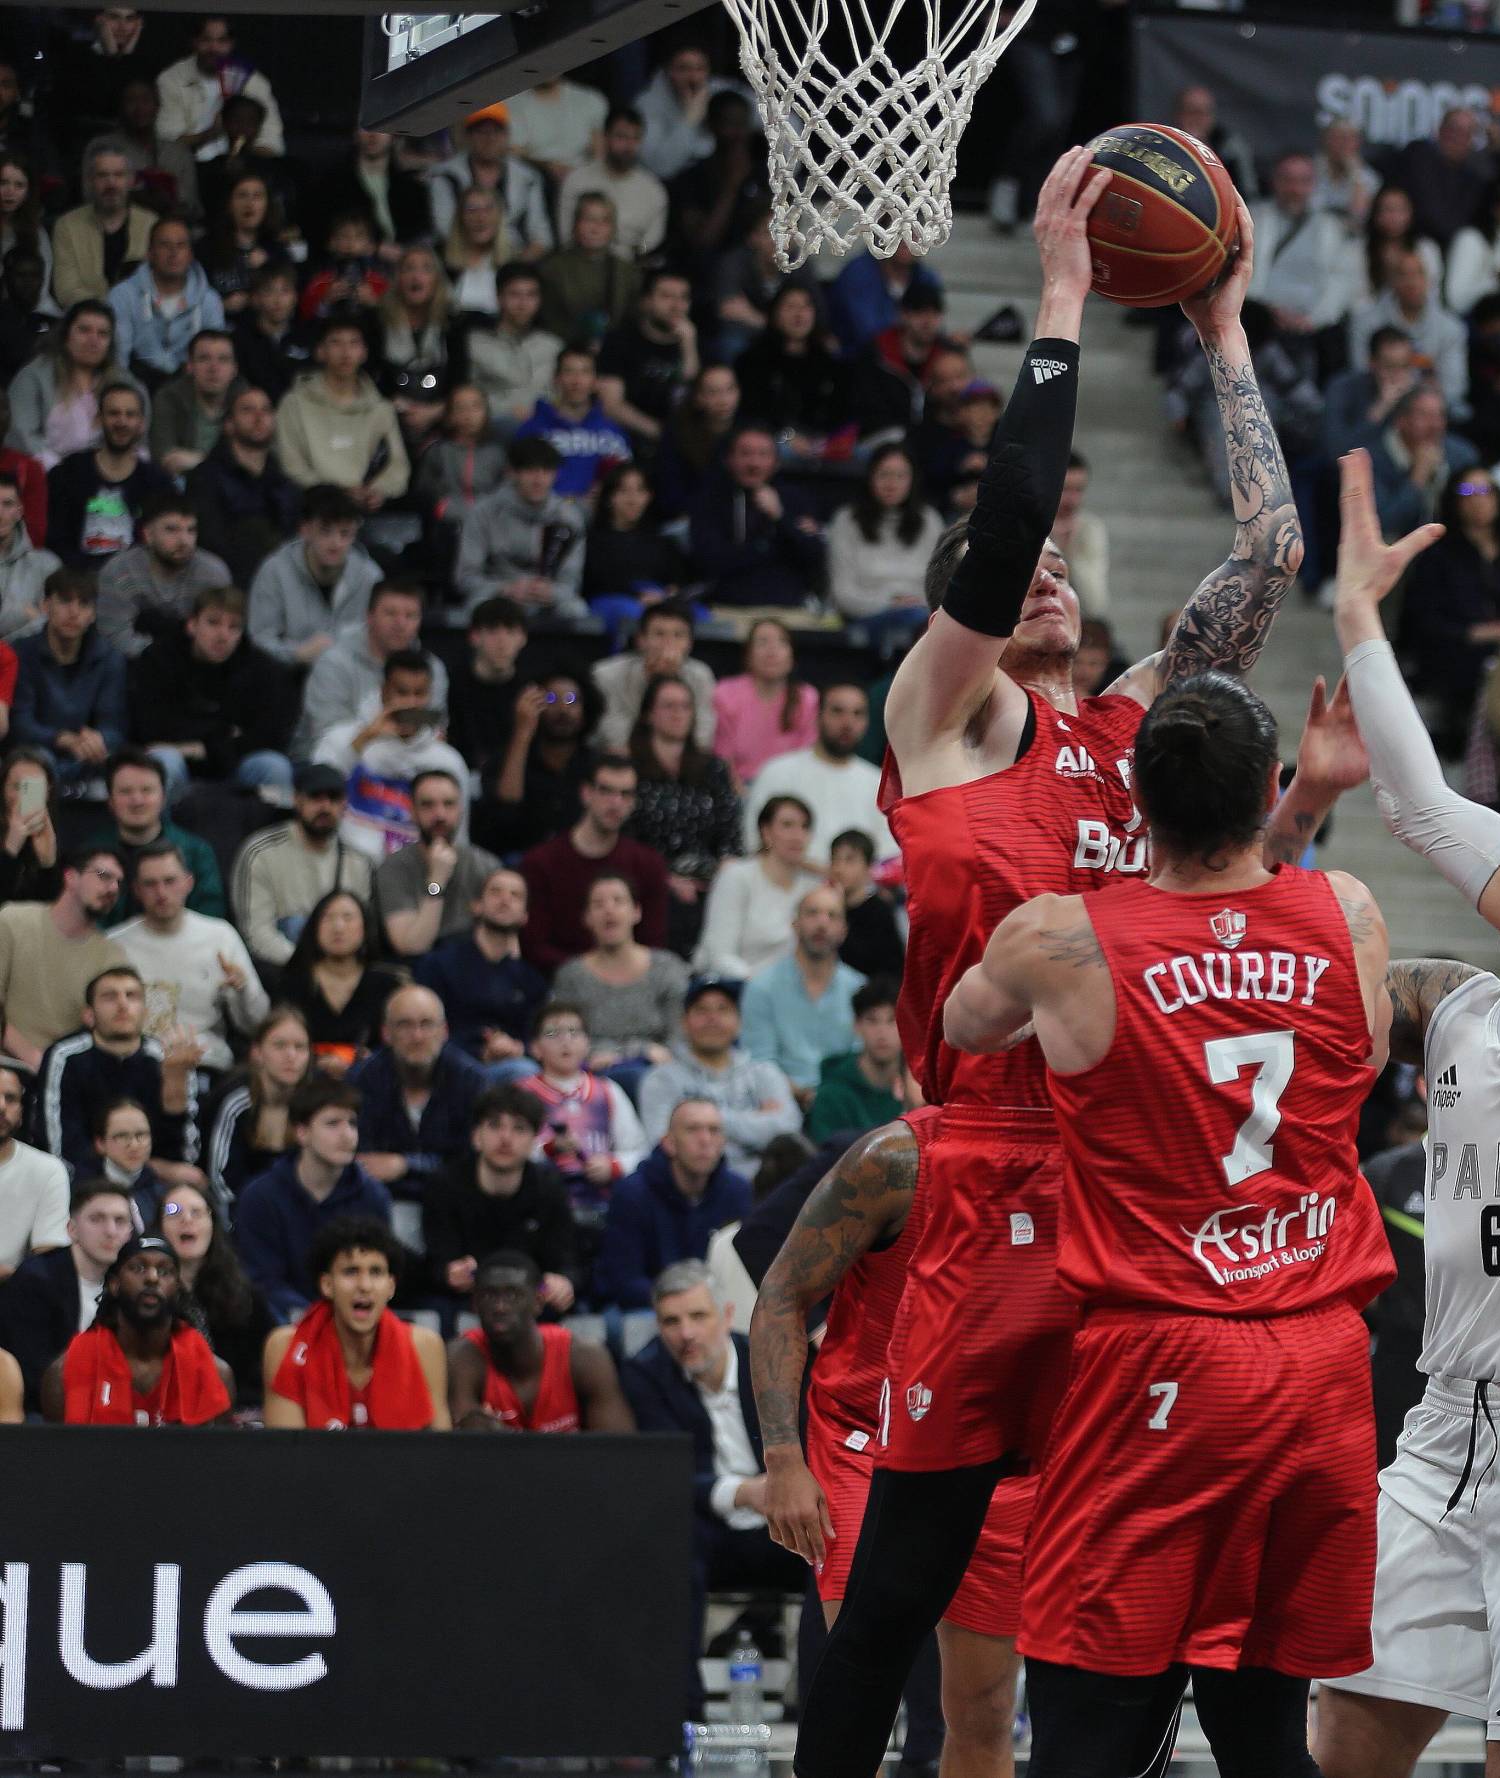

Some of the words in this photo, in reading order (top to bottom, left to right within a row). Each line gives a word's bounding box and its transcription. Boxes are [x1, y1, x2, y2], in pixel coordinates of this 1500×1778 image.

[1030, 358, 1068, 372] adidas
[1143, 951, 1331, 1015] COURBY
[1204, 1029, 1295, 1186] 7
[1149, 1381, 1179, 1430] 7
